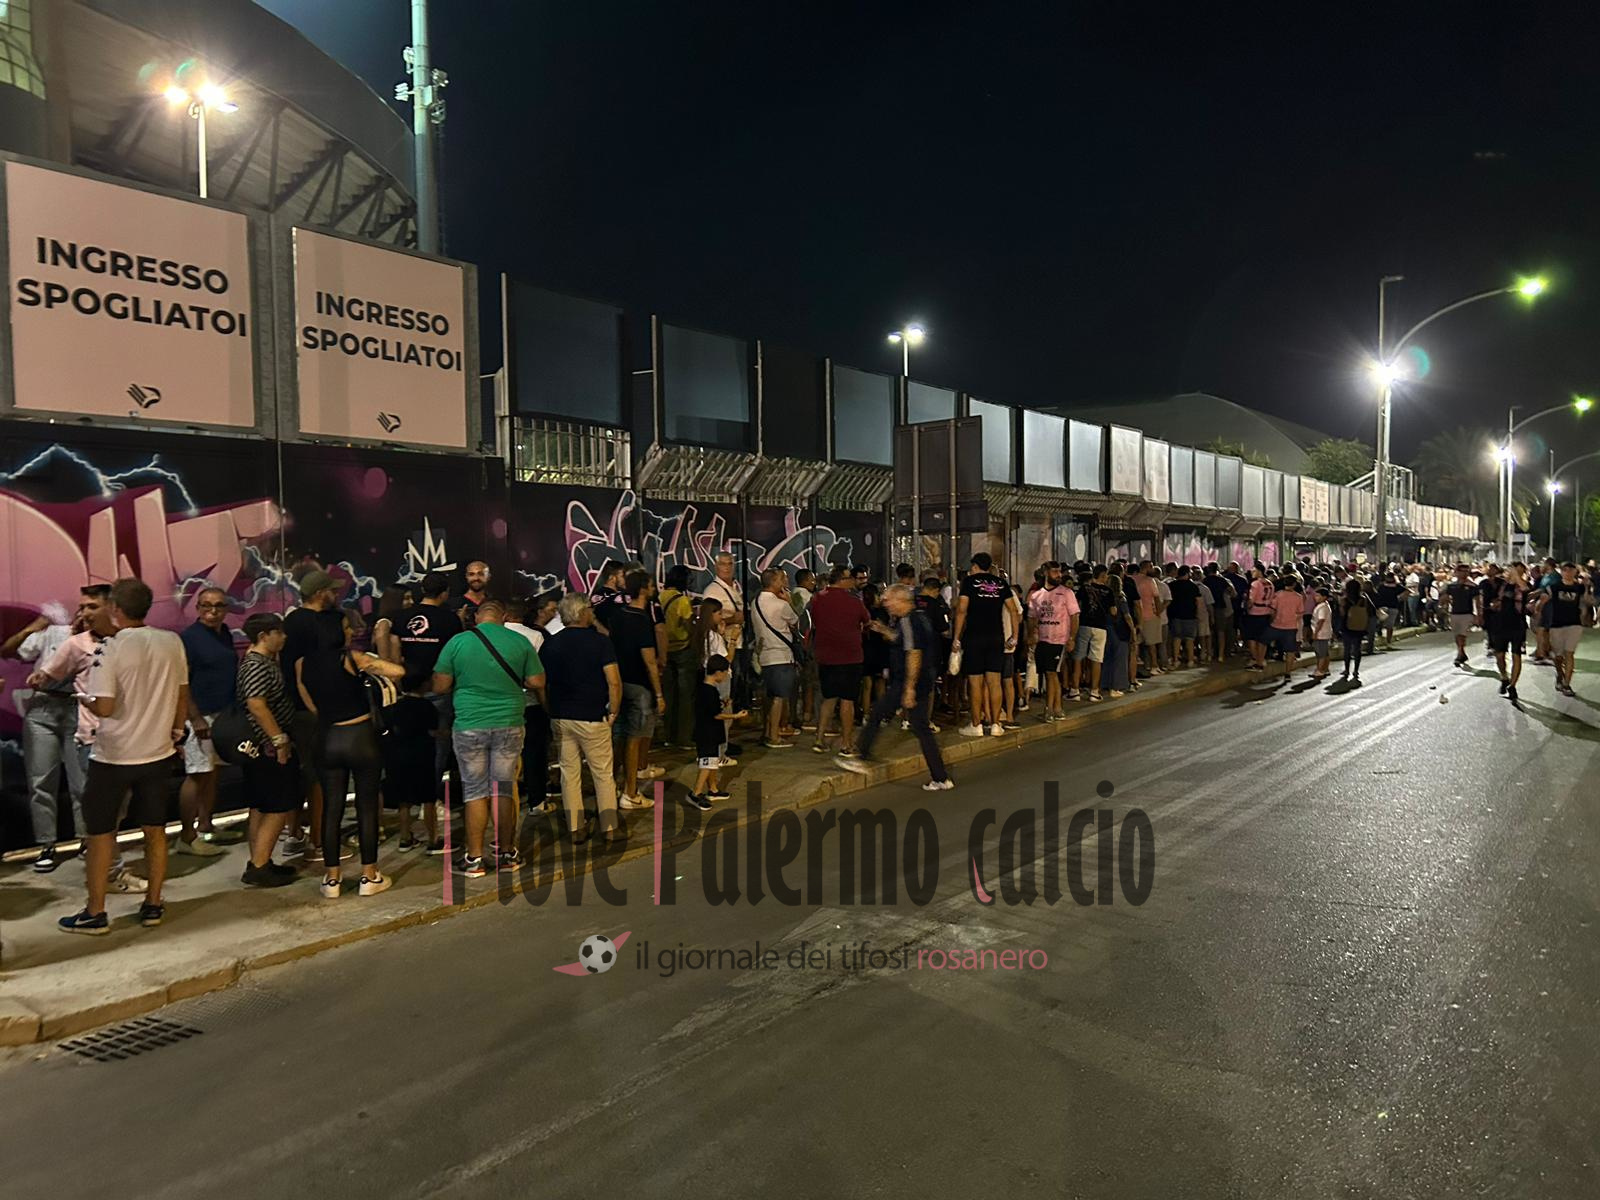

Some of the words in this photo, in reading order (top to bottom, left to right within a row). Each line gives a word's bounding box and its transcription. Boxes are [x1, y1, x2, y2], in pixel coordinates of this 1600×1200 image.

[37, 237, 228, 295] INGRESSO
[17, 278, 247, 337] SPOGLIATOI
[315, 291, 450, 336] INGRESSO
[302, 326, 462, 372] SPOGLIATOI
